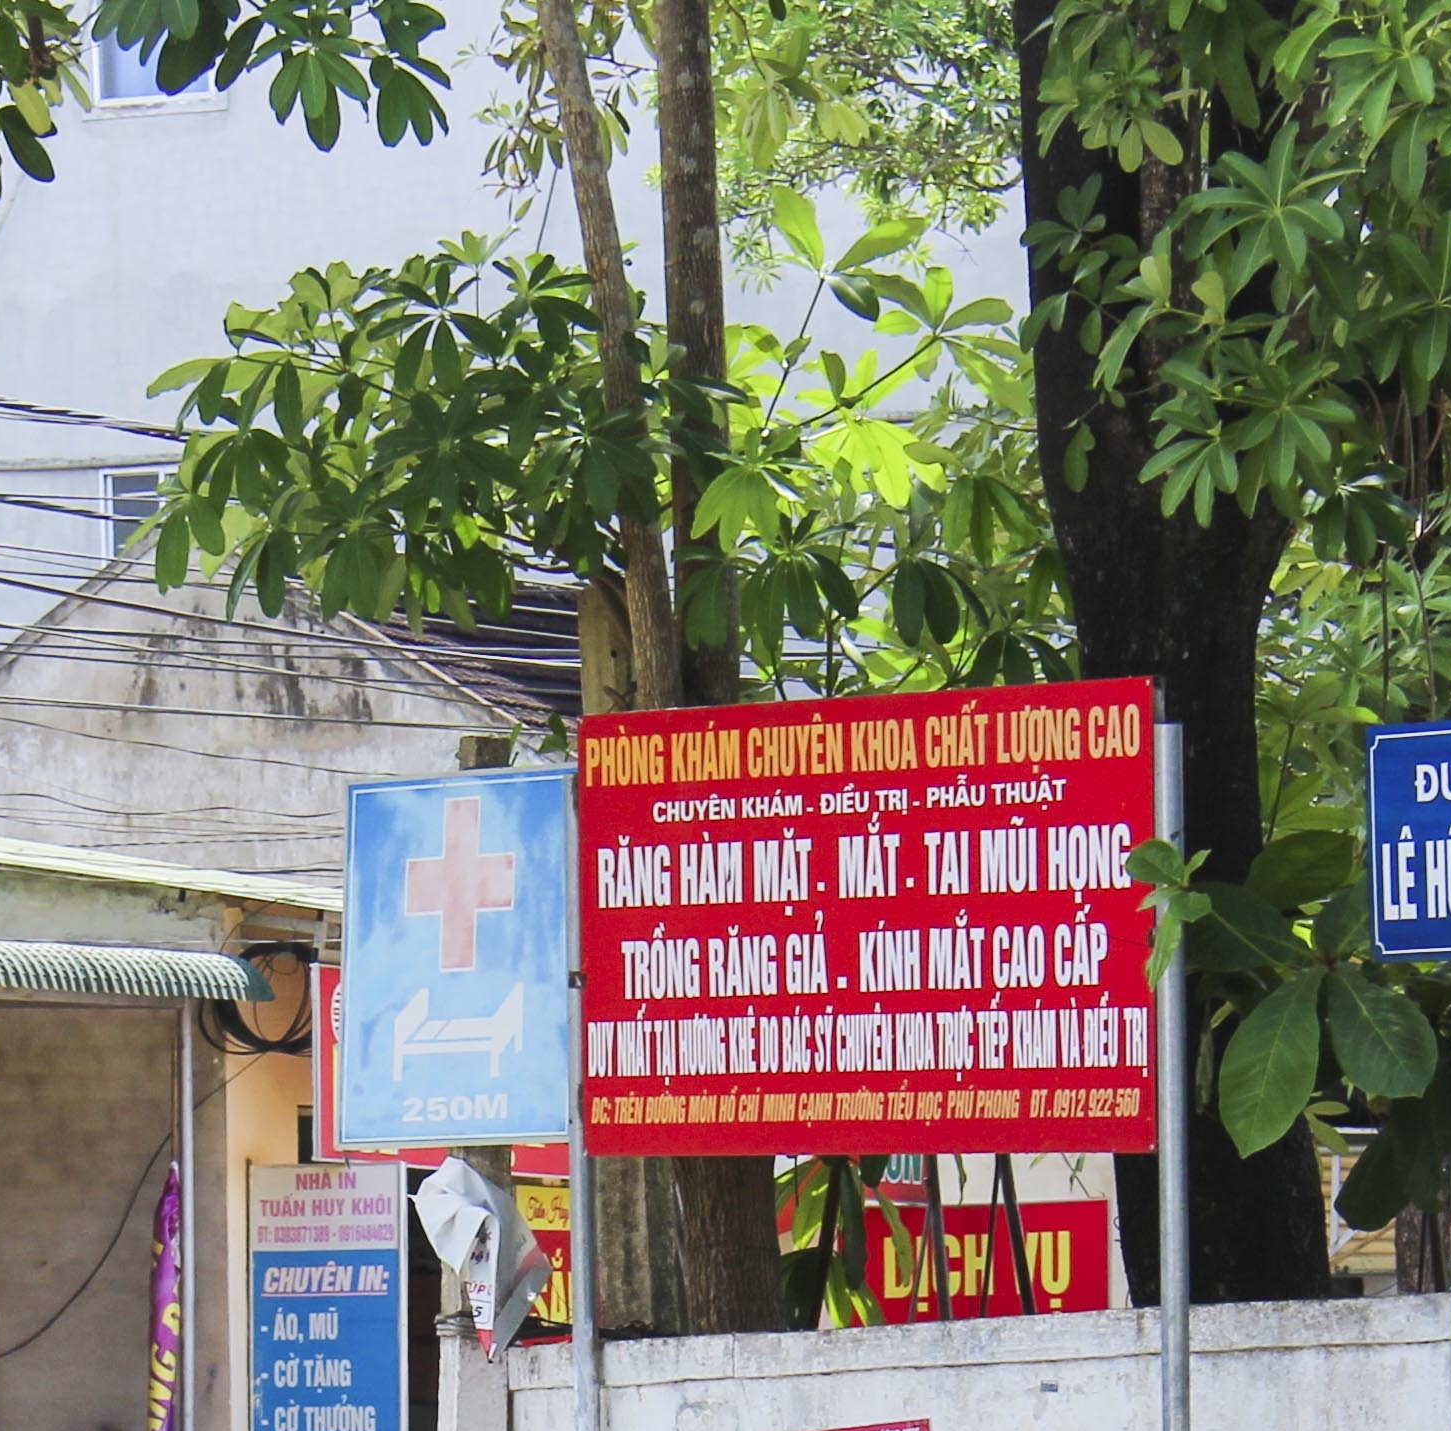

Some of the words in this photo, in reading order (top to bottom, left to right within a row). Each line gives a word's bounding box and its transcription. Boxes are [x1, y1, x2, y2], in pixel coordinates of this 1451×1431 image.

[585, 725, 665, 788] PHÒNG
[670, 721, 741, 783] KHÁM
[747, 713, 844, 778] CHUYÊN
[850, 716, 919, 773] KHOA
[924, 700, 990, 767] CHẤT
[996, 705, 1082, 773] LƯỢNG
[1087, 703, 1141, 759] CAO
[652, 790, 735, 823] CHUYÊN
[741, 789, 802, 818] KHÁM
[991, 778, 1067, 811] THUẬT
[597, 835, 671, 909] RĂNG
[679, 831, 743, 906] HÀM
[753, 827, 813, 916] MẶT
[838, 813, 901, 899] MẮT
[924, 829, 970, 895] TAI
[980, 818, 1037, 893] MŨI
[1047, 823, 1133, 900] HỌNG
[1381, 824, 1419, 920] LÊ
[621, 922, 699, 999] TRỒNG
[707, 925, 777, 997] RĂNG
[785, 911, 828, 995] GIẢ
[858, 920, 920, 992] KÍNH
[927, 911, 985, 990] MẮT
[991, 926, 1044, 988] CAO
[1053, 902, 1107, 987] CẤP
[588, 1020, 614, 1077] DUY
[616, 1003, 651, 1076] NHẤT
[654, 1019, 676, 1086] TẠI
[728, 1005, 756, 1074] KHÊ
[758, 1014, 779, 1073] DO
[782, 1006, 811, 1073] BÁC
[836, 1002, 893, 1072] CHUYÊN
[895, 1012, 935, 1071] KHOA
[1012, 999, 1056, 1068] KHÁM
[1059, 997, 1081, 1068] VÀ
[402, 1094, 508, 1121] 250M
[947, 1084, 974, 1119] PHÚ
[975, 1089, 1020, 1119] PHONG
[295, 1169, 331, 1190] NHÀ
[339, 1172, 356, 1189] IN
[312, 1199, 345, 1216] HUY
[263, 1263, 351, 1293] CHUYÊN
[309, 1309, 338, 1340] MŨ
[274, 1353, 299, 1388] CỜ
[303, 1356, 352, 1394] TẶNG
